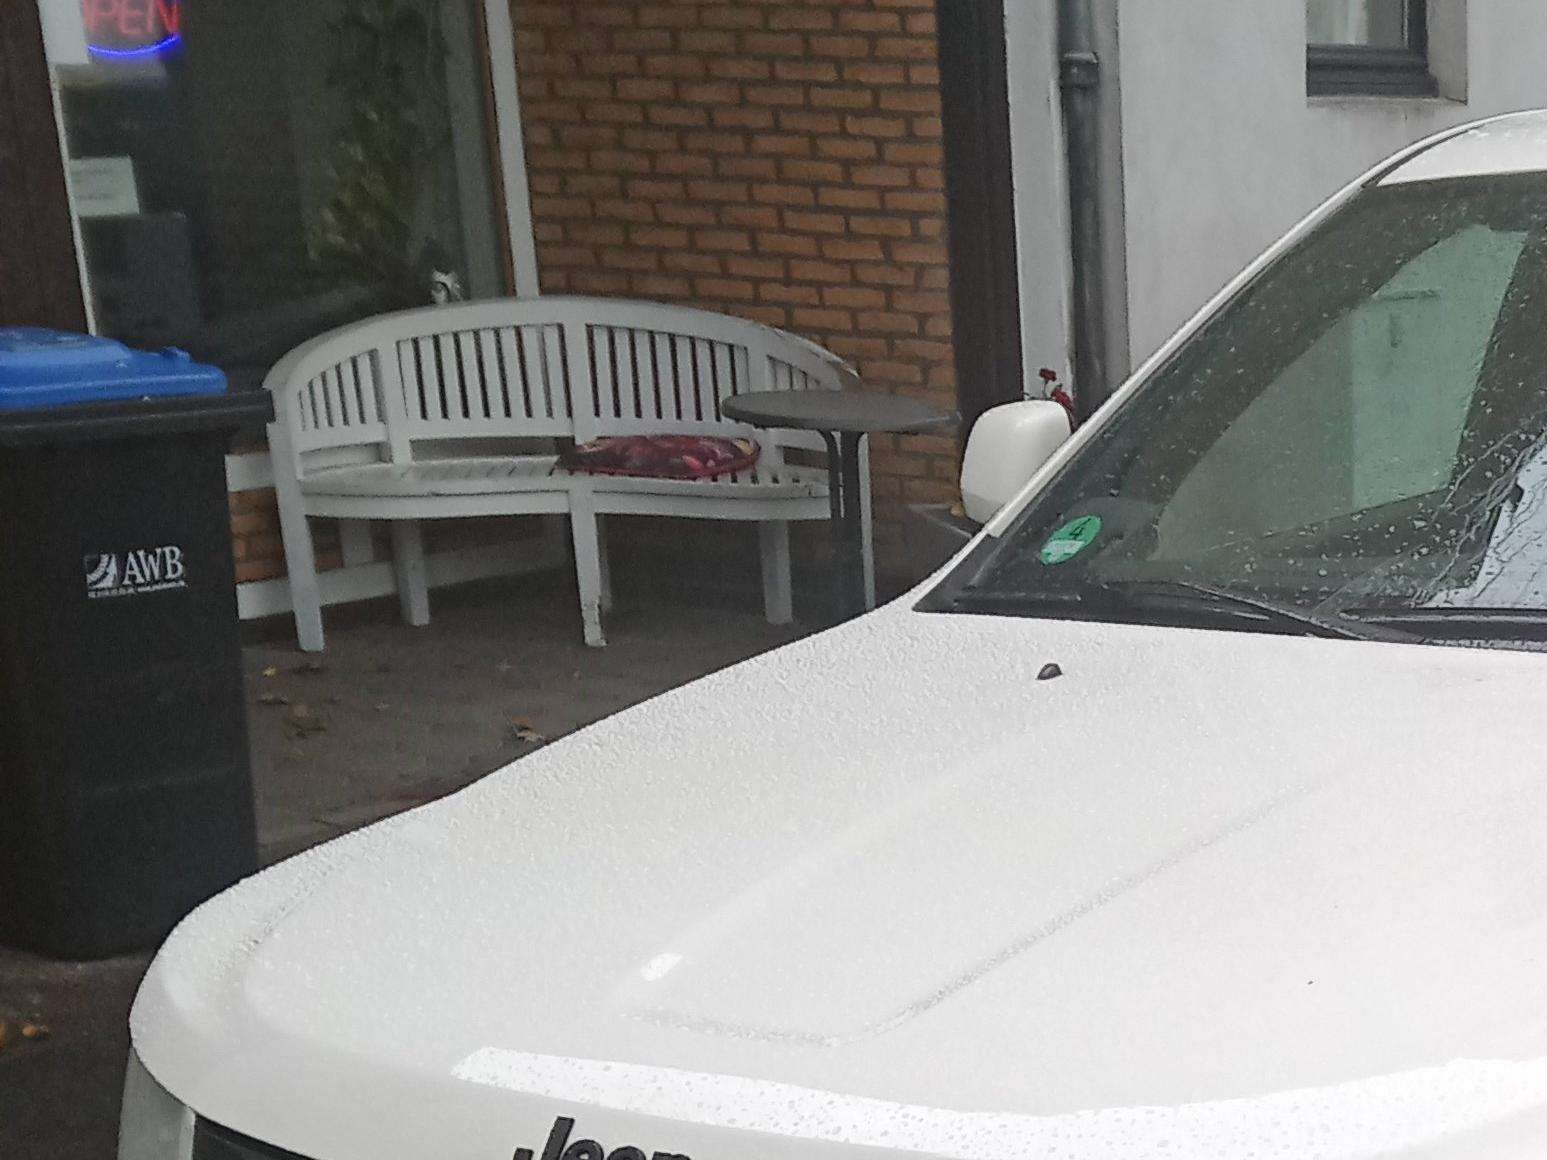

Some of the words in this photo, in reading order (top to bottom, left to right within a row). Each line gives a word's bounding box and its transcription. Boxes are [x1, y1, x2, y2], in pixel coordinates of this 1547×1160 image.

[83, 0, 181, 36] PEN
[1069, 517, 1092, 540] 4
[122, 545, 184, 585] AWB
